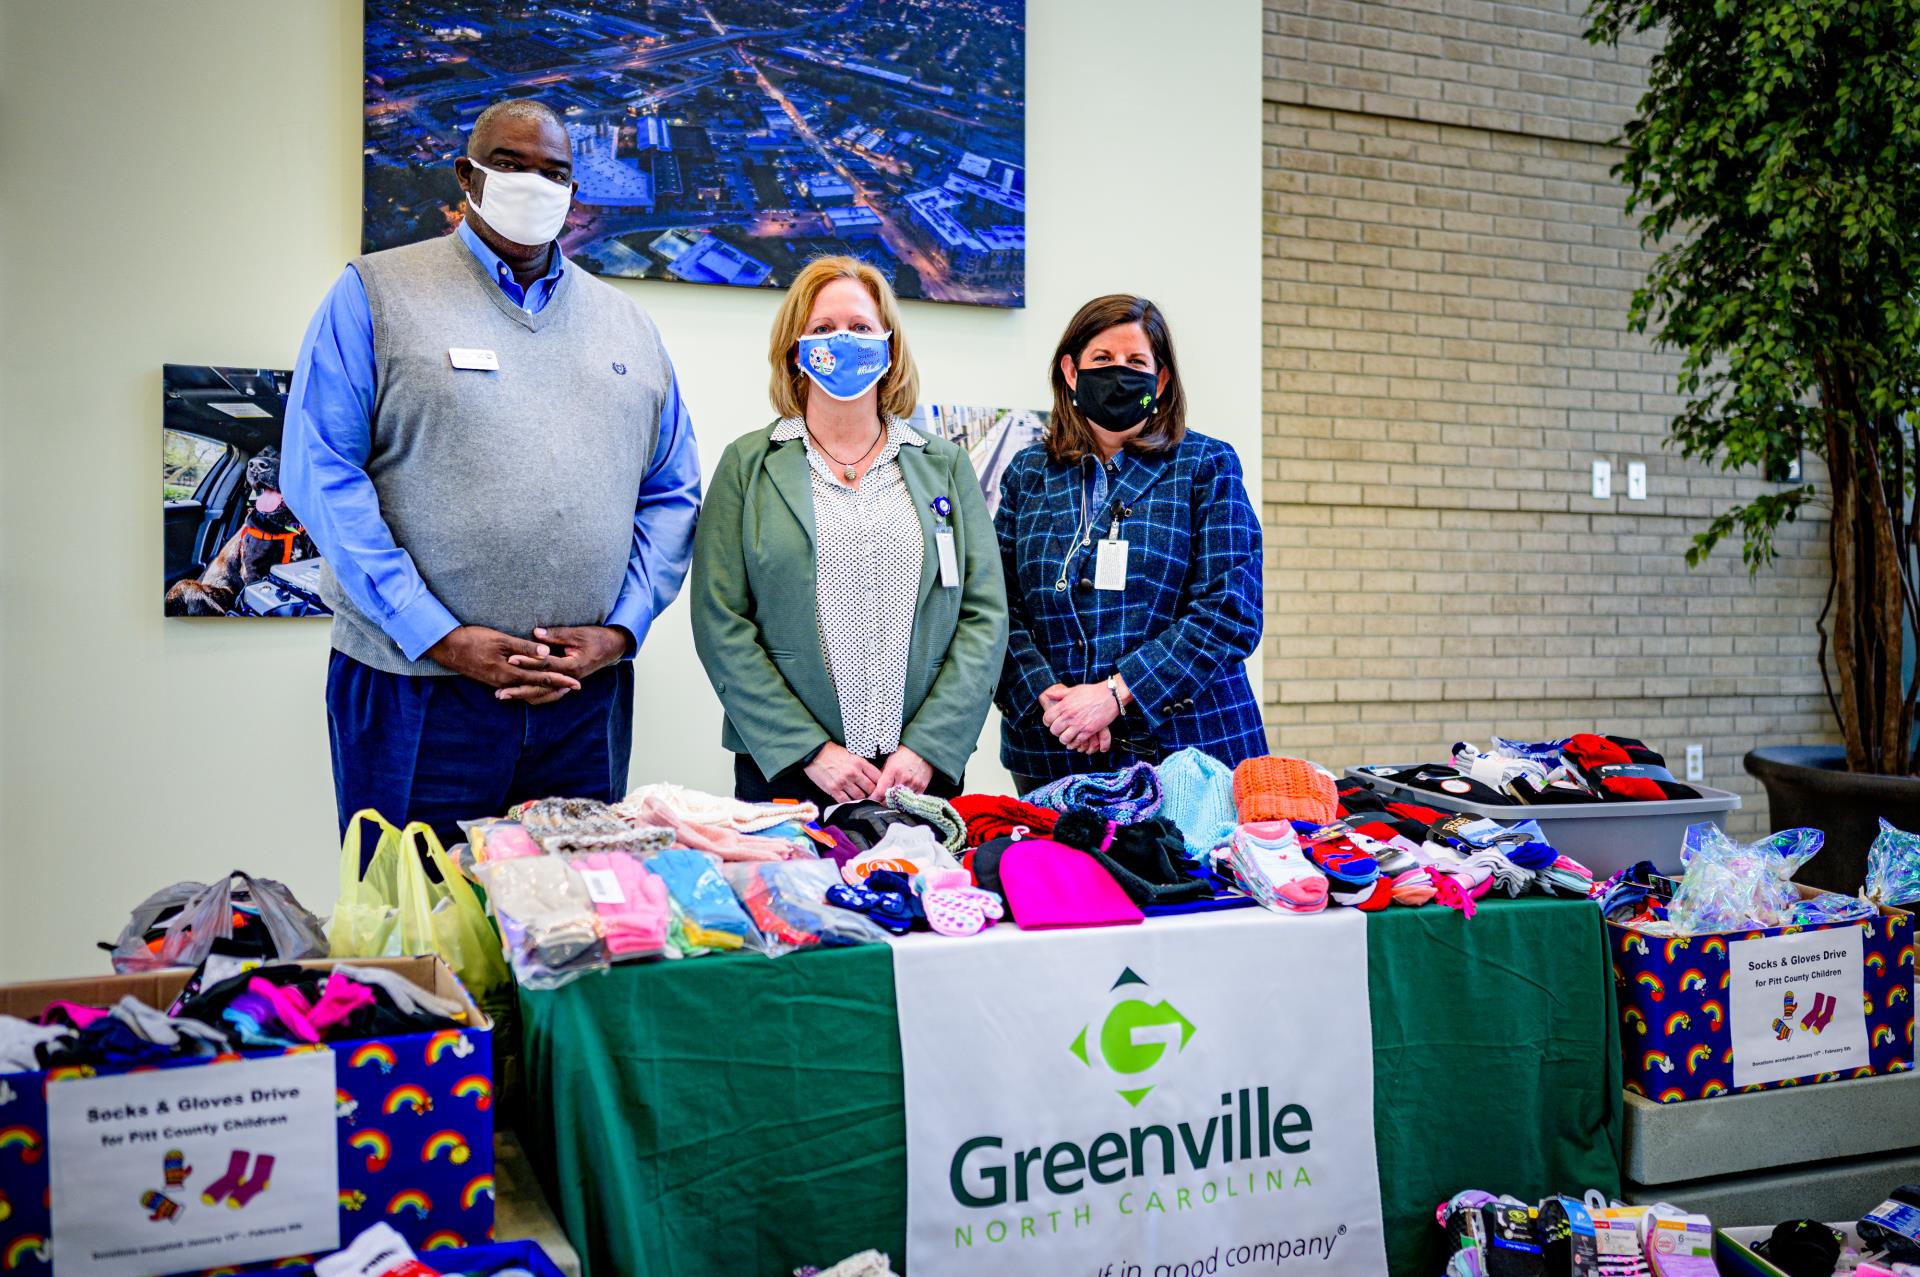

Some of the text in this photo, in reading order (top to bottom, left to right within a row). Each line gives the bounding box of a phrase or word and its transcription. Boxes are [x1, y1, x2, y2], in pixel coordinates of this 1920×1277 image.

[1748, 949, 1847, 971] Socks & Gloves Drive
[1755, 968, 1842, 988] for Pitt County Children
[1796, 1052, 1813, 1060] January
[86, 1086, 301, 1124] Socks & Gloves Drive
[100, 1113, 289, 1148] for Pitt County Children
[950, 1086, 1313, 1209] Greenville
[955, 1166, 1313, 1248] NORTH CAROLINA
[1120, 1260, 1142, 1277] in
